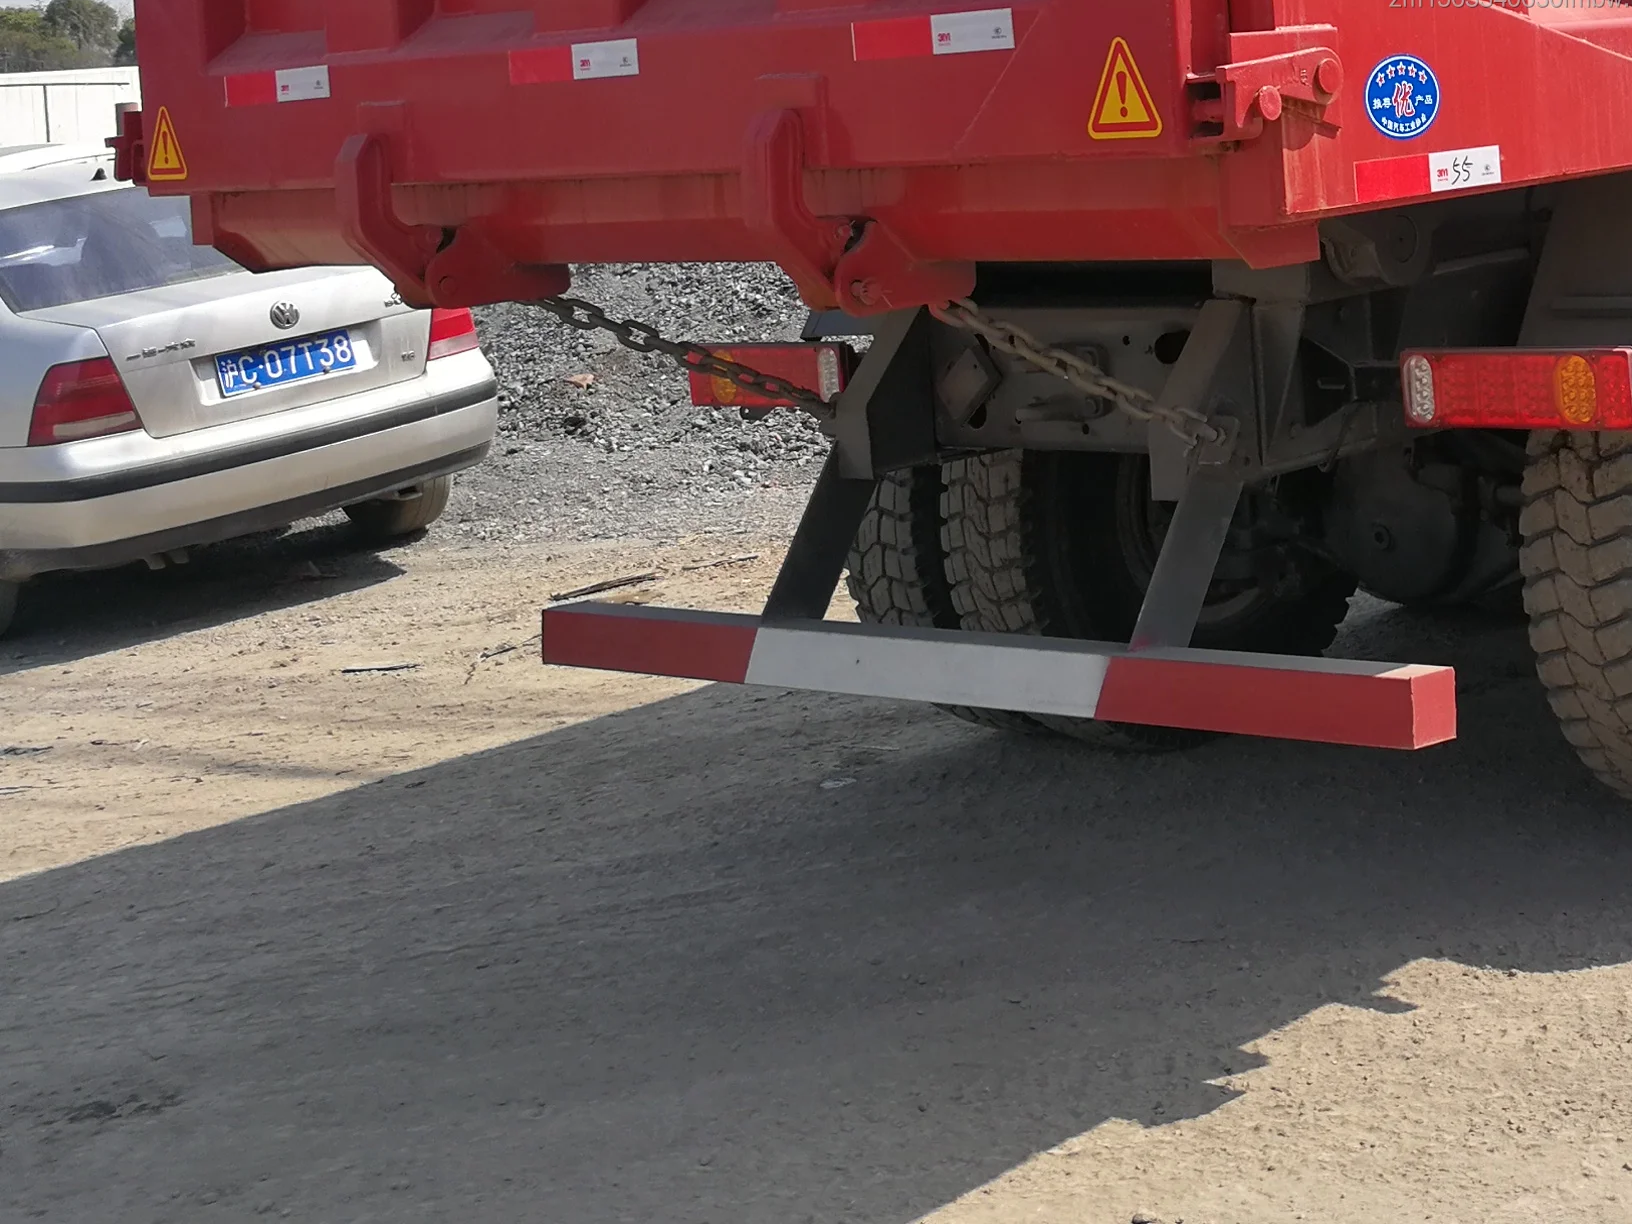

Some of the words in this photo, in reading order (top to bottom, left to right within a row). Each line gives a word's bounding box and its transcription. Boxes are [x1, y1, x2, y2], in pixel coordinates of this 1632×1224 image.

[937, 32, 951, 43] 3M
[579, 59, 591, 68] 3M
[1391, 80, 1416, 119] 优
[1414, 94, 1433, 107] 产品
[1436, 167, 1449, 179] 3M
[1451, 155, 1474, 186] 55
